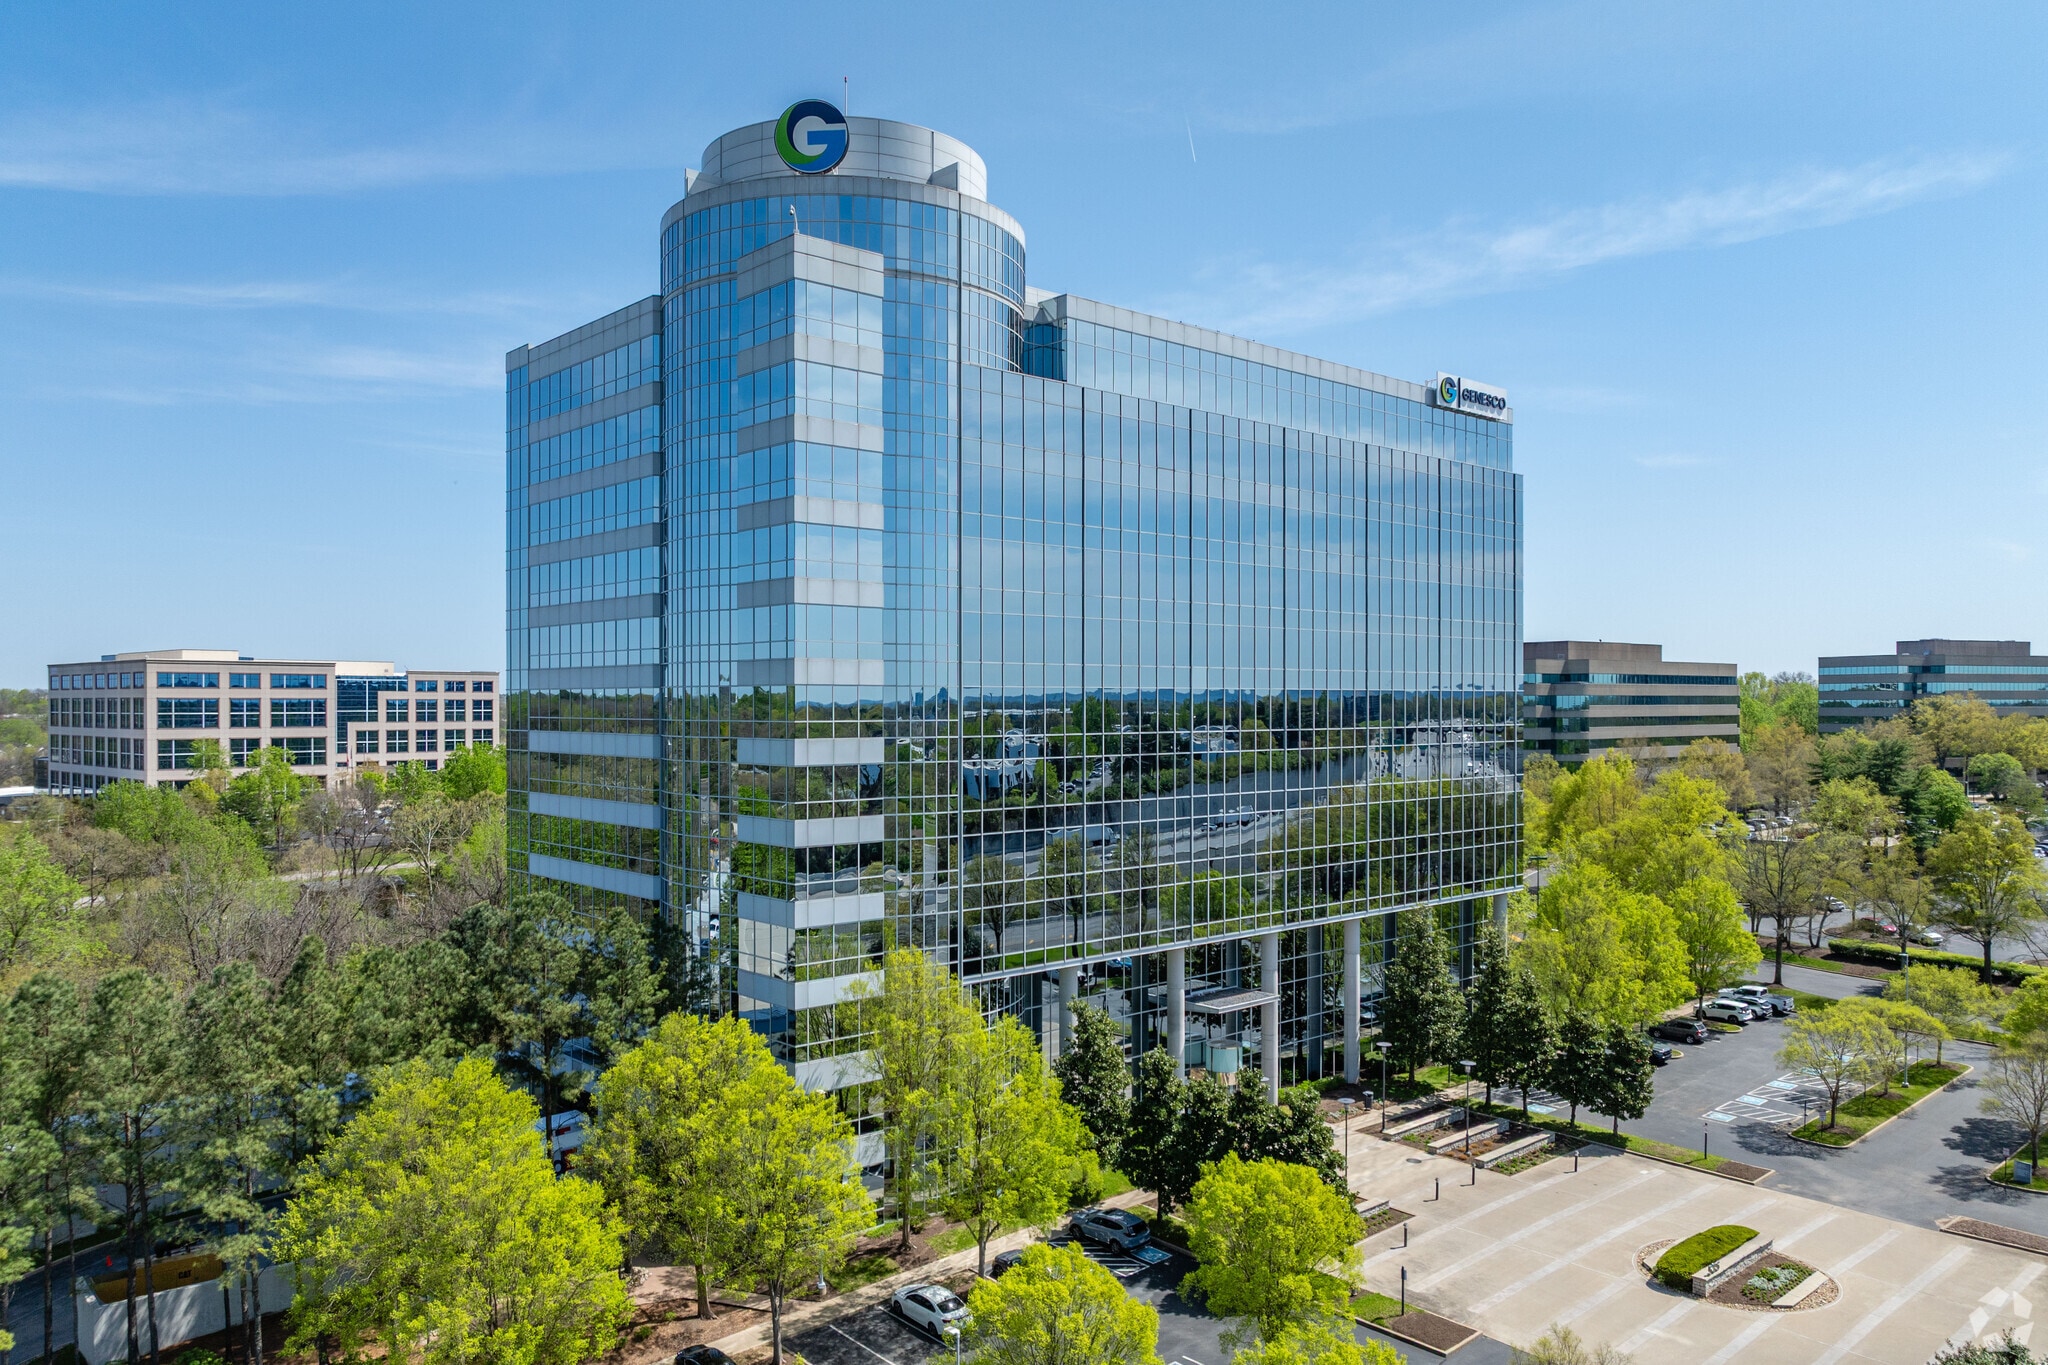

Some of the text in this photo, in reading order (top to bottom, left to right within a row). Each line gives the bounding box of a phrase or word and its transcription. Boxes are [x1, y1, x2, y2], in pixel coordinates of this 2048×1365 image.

[775, 99, 849, 174] G
[1441, 377, 1506, 410] G GENESCO
